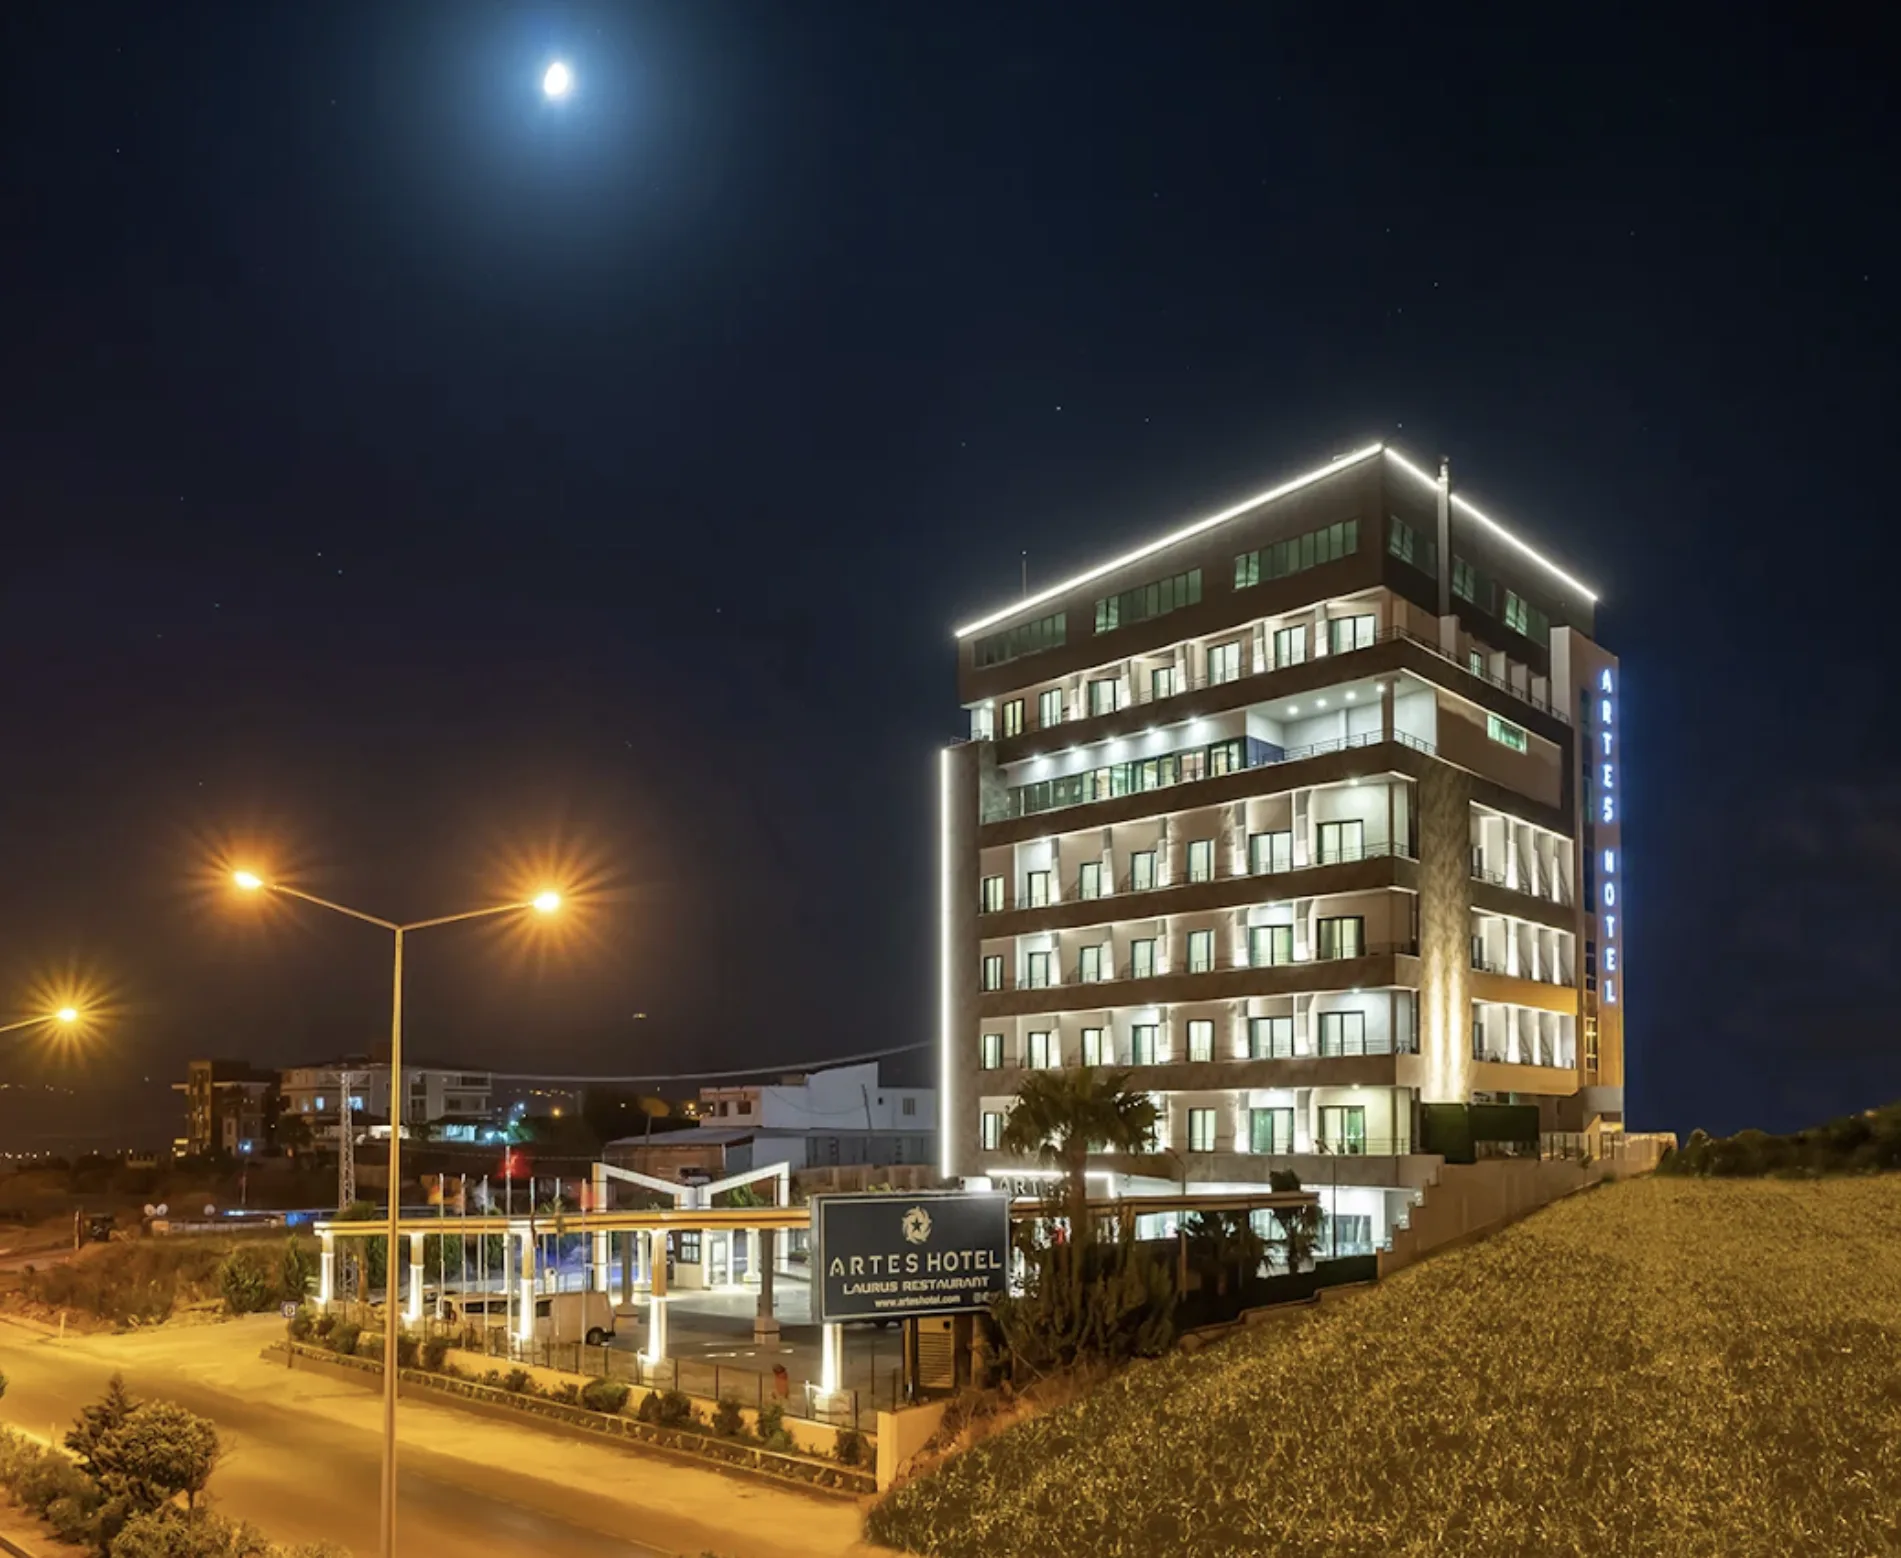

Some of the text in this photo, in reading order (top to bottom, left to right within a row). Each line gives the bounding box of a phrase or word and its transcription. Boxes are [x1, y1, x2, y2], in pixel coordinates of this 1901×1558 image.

[1602, 668, 1616, 1003] ARTES HOTEL
[829, 1250, 1001, 1277] ARTES HOTEL
[843, 1276, 990, 1295] LAURUS RESTAURANT
